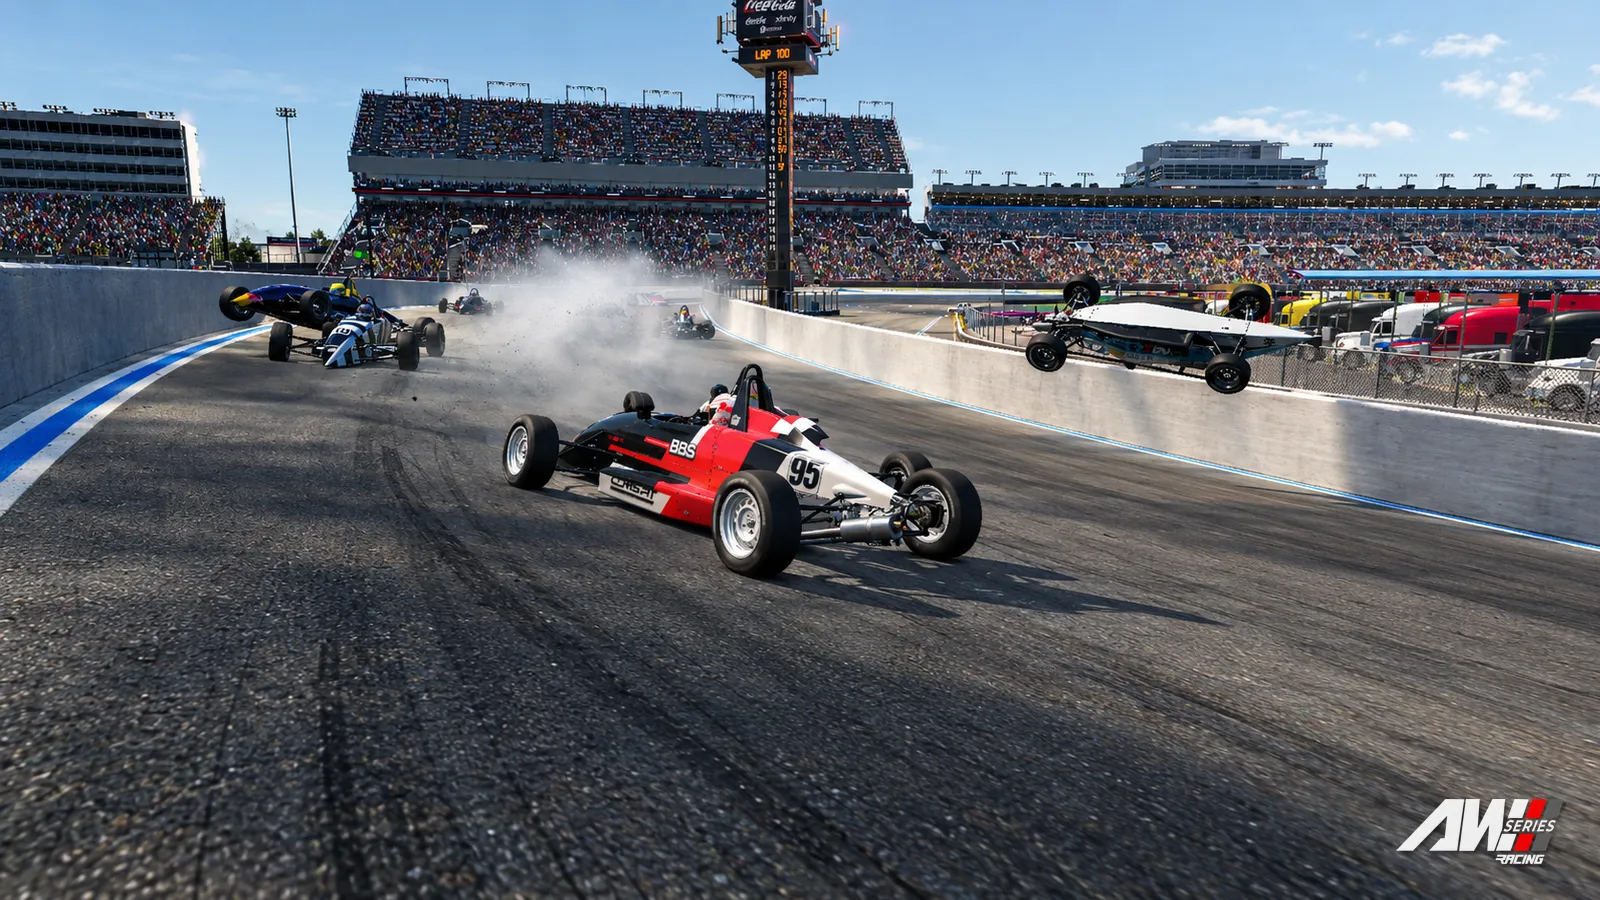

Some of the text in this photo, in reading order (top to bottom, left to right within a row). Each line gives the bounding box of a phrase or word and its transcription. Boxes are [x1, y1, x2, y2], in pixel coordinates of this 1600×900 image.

[755, 48, 790, 60] LAP 100
[778, 70, 788, 80] 29
[669, 438, 697, 460] BBS
[789, 458, 820, 490] 95
